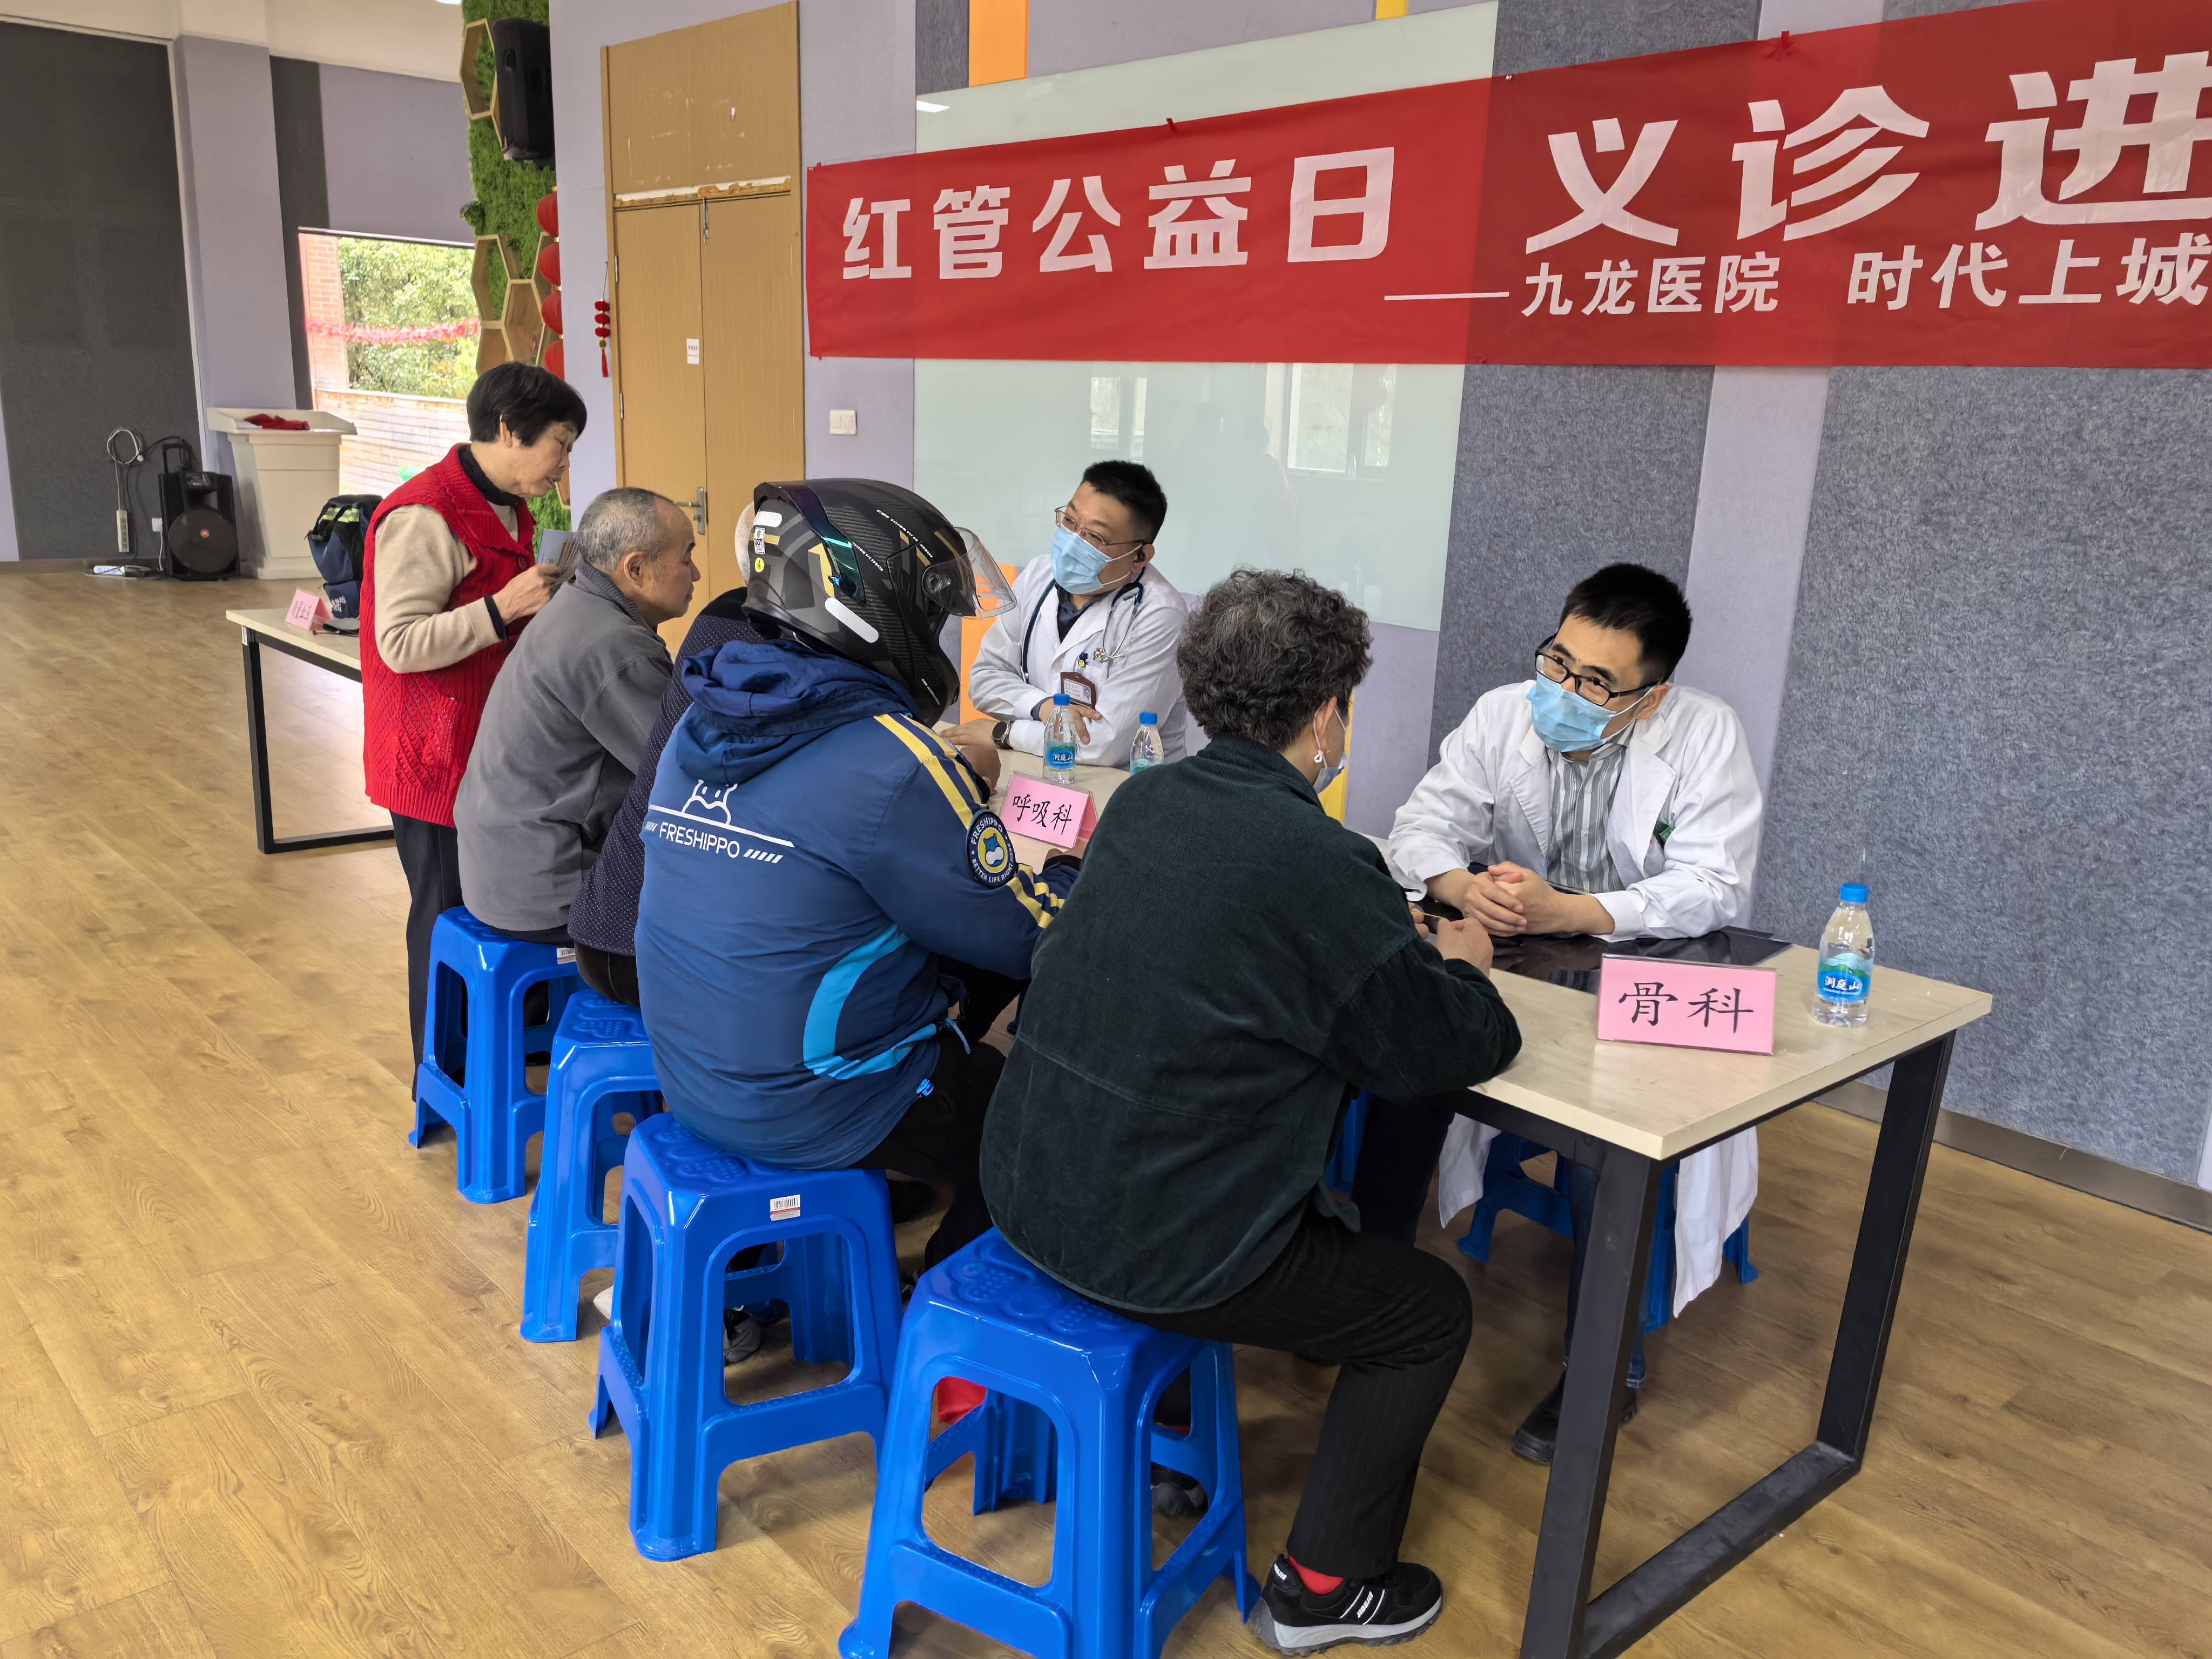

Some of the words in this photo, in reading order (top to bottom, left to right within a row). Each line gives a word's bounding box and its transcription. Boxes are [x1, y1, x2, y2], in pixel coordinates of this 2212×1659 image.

[842, 147, 1395, 280] 红管公益日
[1525, 51, 2212, 254] 义诊进
[1846, 232, 2211, 310] 时代上城
[971, 817, 1003, 845] FRESHIPPO
[1012, 793, 1072, 835] 呼吸科
[659, 821, 740, 858] FRESHIPPO
[972, 858, 988, 881] BETTER
[1825, 976, 1860, 991] 洞庭山
[1618, 982, 1755, 1034] 骨科
